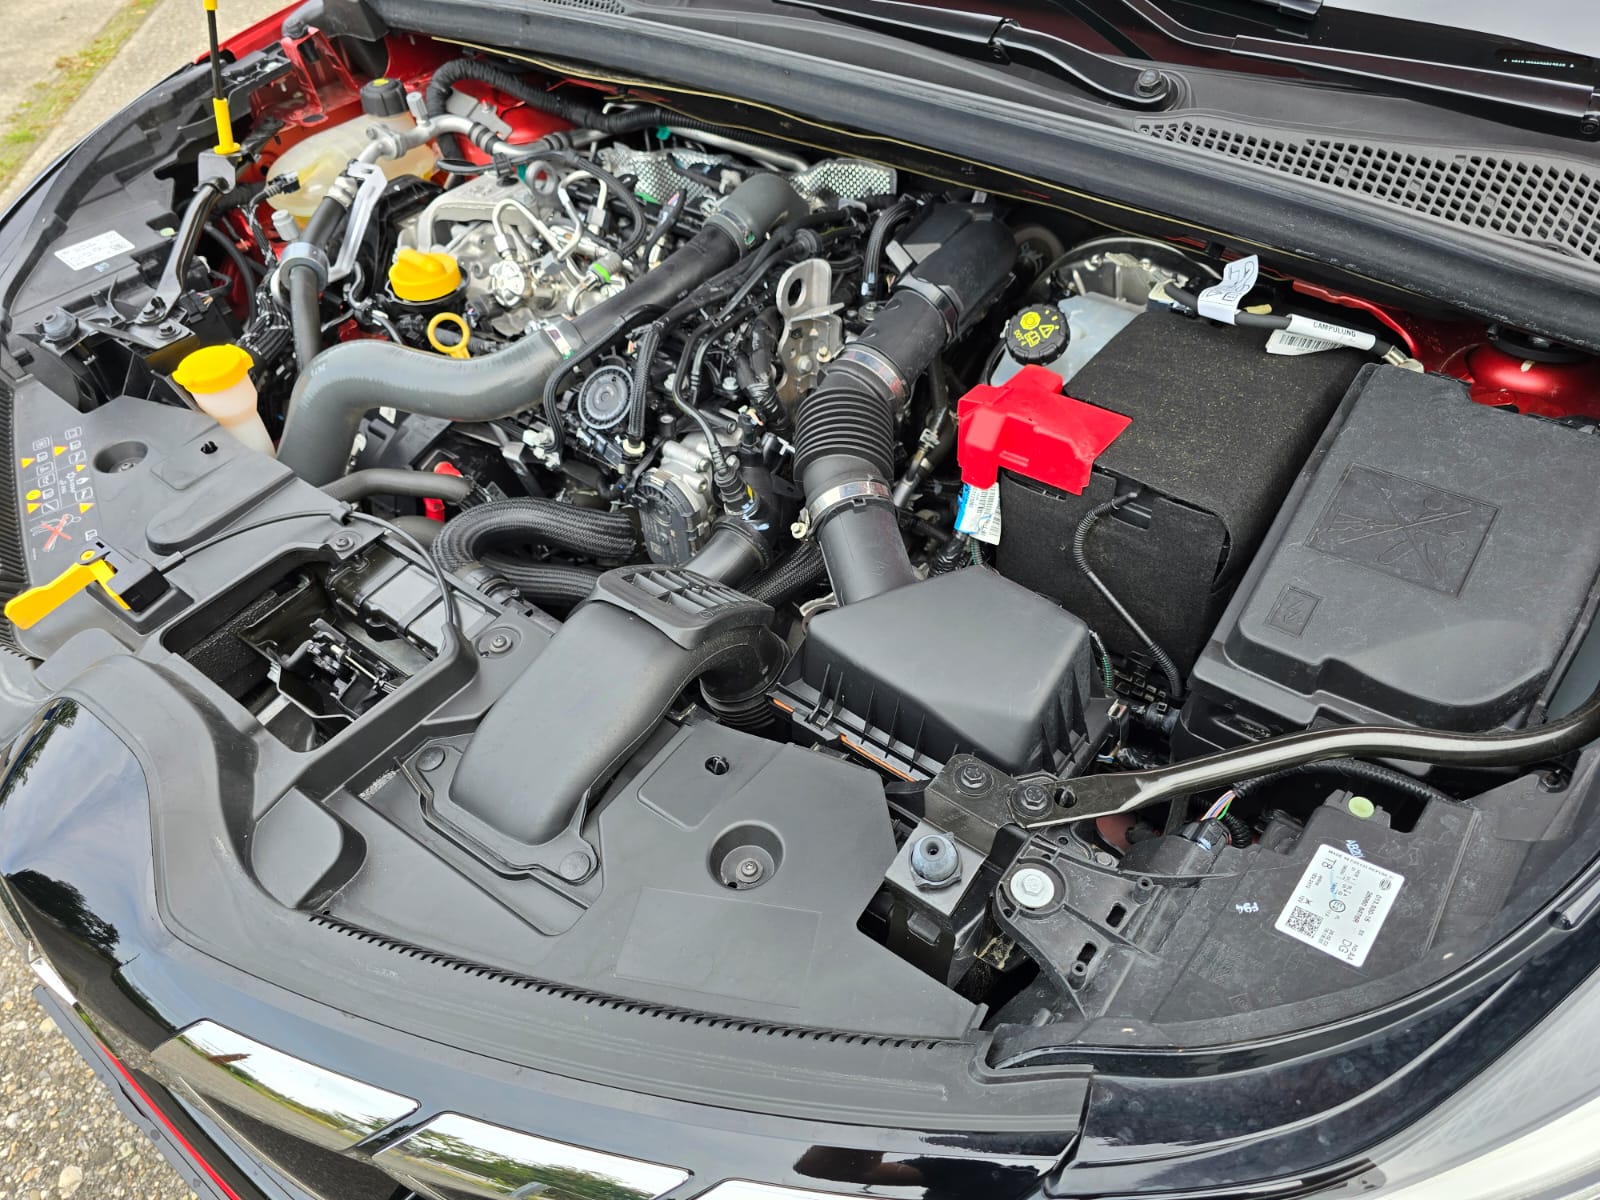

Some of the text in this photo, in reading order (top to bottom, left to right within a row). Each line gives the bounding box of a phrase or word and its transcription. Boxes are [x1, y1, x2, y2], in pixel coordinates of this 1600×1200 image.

[1013, 329, 1025, 341] DOT
[1313, 321, 1356, 338] CAMPULUNG
[1321, 858, 1337, 870] T8
[1338, 938, 1353, 954] DG
